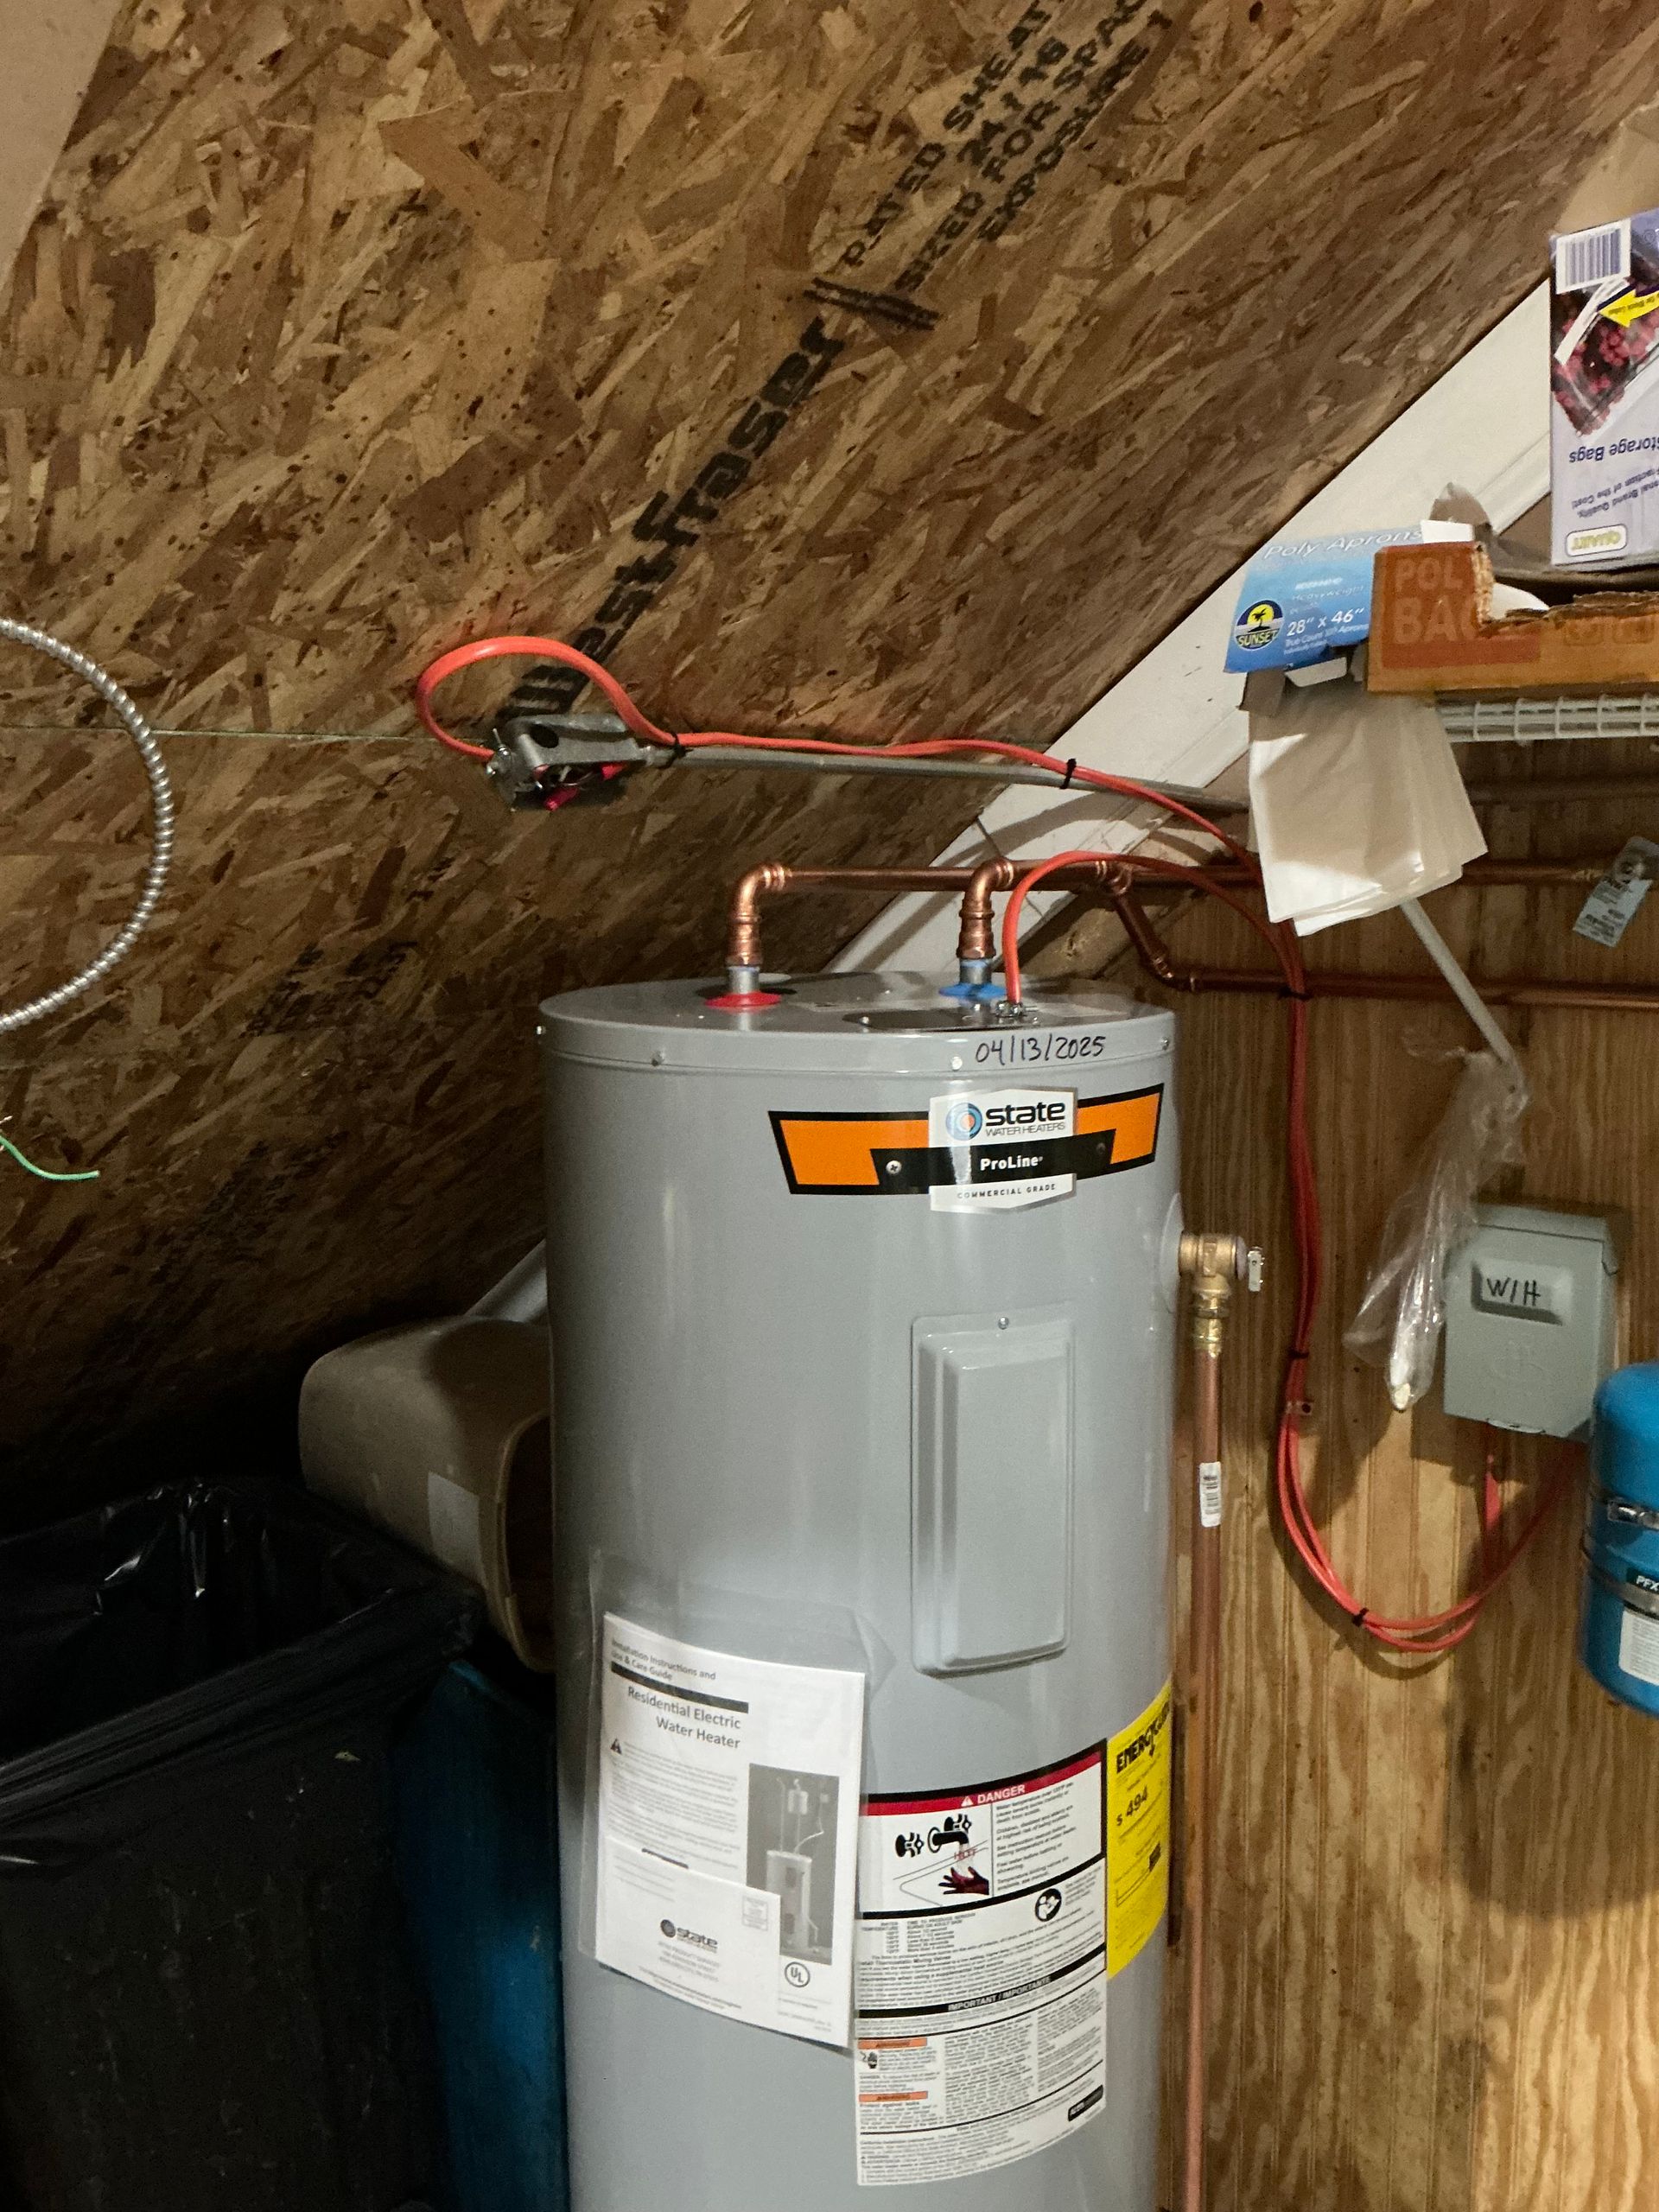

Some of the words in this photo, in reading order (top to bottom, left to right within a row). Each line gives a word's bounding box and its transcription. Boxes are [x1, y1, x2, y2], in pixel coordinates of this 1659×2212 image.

[981, 99, 1062, 184] FOR
[1568, 445, 1605, 463] Bags
[1611, 489, 1639, 506] Brand
[1264, 542, 1321, 560] Poly
[1326, 531, 1423, 552] Aprons
[1236, 629, 1279, 647] SUNSET
[976, 1033, 1107, 1066] 04/13/2025
[985, 1102, 1066, 1127] state
[986, 1126, 1022, 1137] WATER
[1022, 1122, 1066, 1135] HEATERS
[957, 1185, 1022, 1199] COMMERCIAL
[1027, 1183, 1057, 1193] GRADE
[632, 1658, 648, 1673] Care
[649, 1666, 674, 1681] Guide
[650, 1656, 698, 1676] Instructions
[699, 1670, 717, 1681] and
[628, 1686, 690, 1719] Residential
[694, 1707, 742, 1730] Electric
[656, 1715, 694, 1738] Water
[696, 1728, 741, 1750] Heater
[977, 1784, 1026, 1804] DANGER
[677, 1927, 719, 1949] state
[947, 1994, 998, 2012] IMPORTANT
